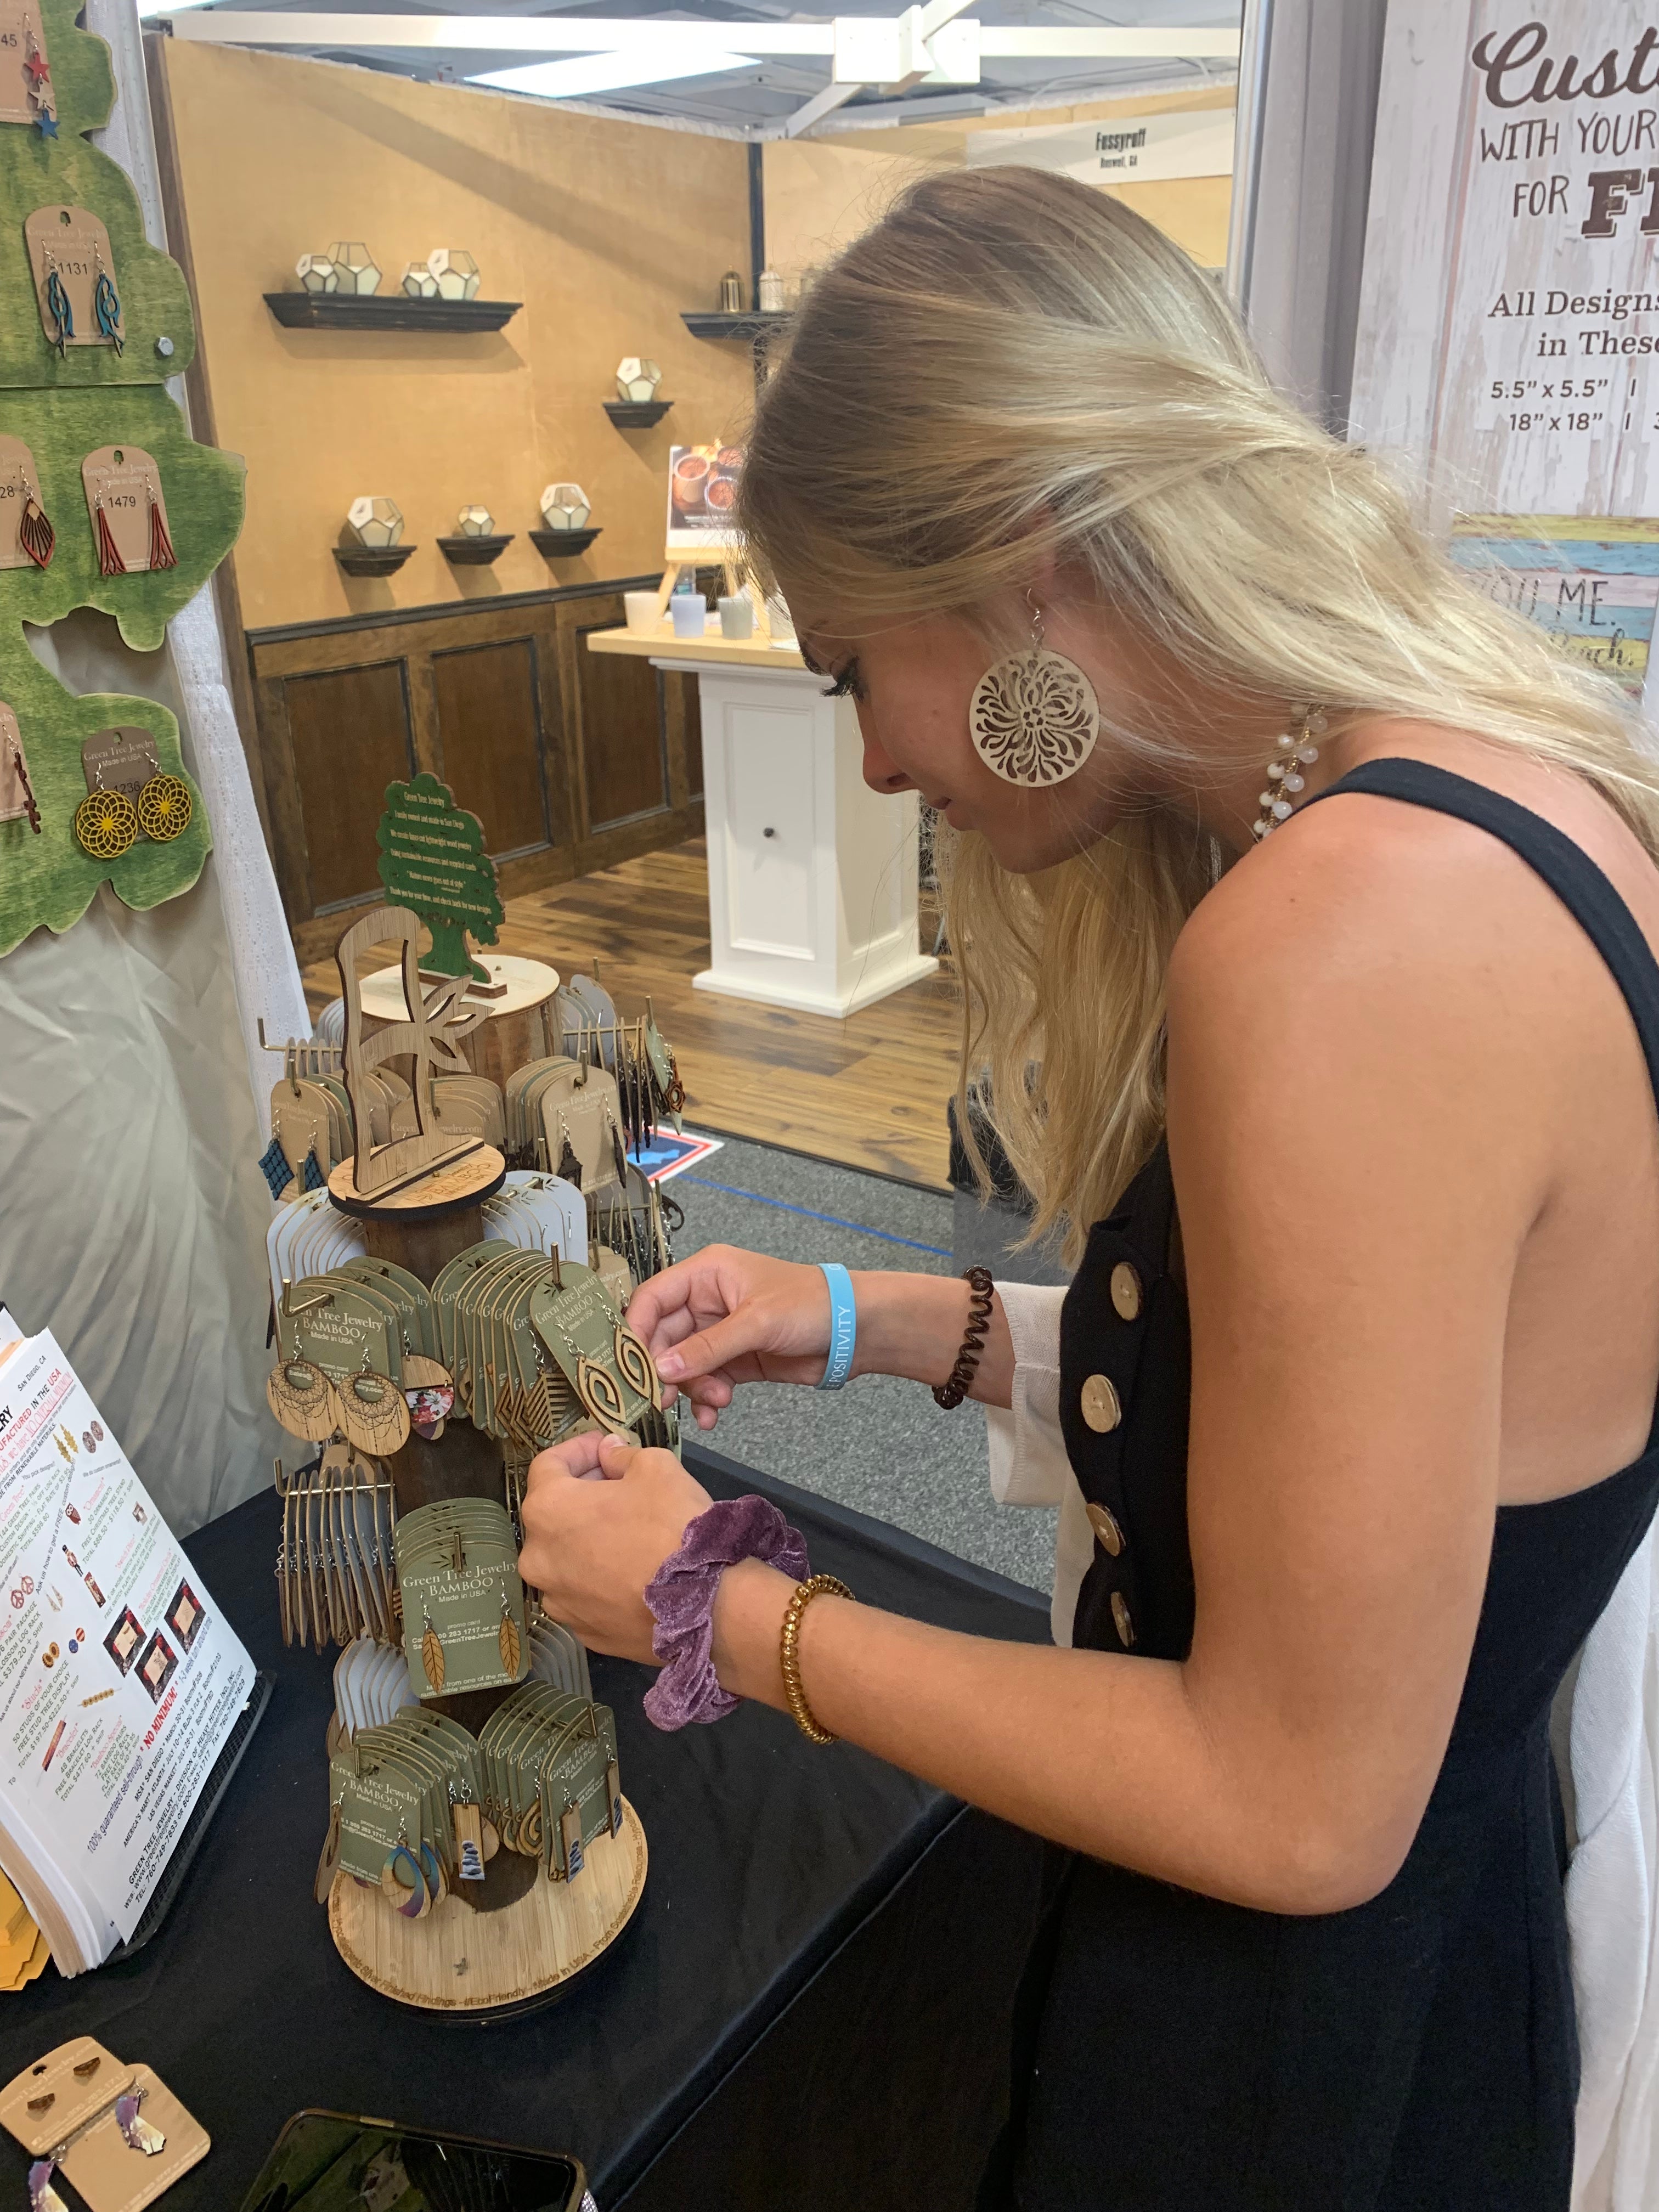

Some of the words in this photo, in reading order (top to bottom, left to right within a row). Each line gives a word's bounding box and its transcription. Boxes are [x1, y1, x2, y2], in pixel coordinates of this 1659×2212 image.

[1481, 119, 1559, 162] WITH
[1577, 109, 1656, 156] YOUR
[1513, 175, 1570, 218] FOR
[58, 262, 88, 275] 1131
[1488, 291, 1534, 318] All
[1537, 332, 1567, 357] in
[1541, 383, 1554, 398] x
[1548, 417, 1561, 431] x
[108, 496, 136, 508] 1479
[83, 751, 108, 761] Green
[109, 747, 127, 755] Tree
[129, 740, 155, 753] Jewelry
[101, 759, 120, 767] Made
[127, 753, 143, 761] USA
[114, 781, 140, 794] 1236
[535, 1306, 560, 1325] Green
[556, 1294, 575, 1308] Tree
[573, 1274, 599, 1300] Jewelry
[556, 1295, 593, 1324] BAMBOO
[303, 1319, 360, 1338] BAMBOO
[314, 1308, 341, 1322] Tree
[342, 1312, 383, 1332] Jewelry
[311, 1331, 329, 1340] Made
[338, 1336, 354, 1345] USA
[828, 1305, 851, 1383] POSITIVITY
[18, 1380, 27, 1391] SAN
[26, 1365, 40, 1381] DIEGO,
[39, 1355, 46, 1364] CA
[31, 1398, 38, 1409] IN
[37, 1384, 49, 1400] THE
[47, 1368, 61, 1385] USA
[3, 1474, 16, 1490] FROM
[14, 1444, 38, 1475] RENEWABLE
[36, 1423, 57, 1447] MATERIALS.
[41, 1571, 46, 1579] us
[54, 1508, 64, 1528] FREE
[61, 1483, 71, 1505] custom
[403, 1574, 440, 1588] Green
[443, 1568, 472, 1581] Tree
[474, 1561, 518, 1579] Jewelry
[430, 1577, 494, 1596] BAMBOO
[439, 1595, 459, 1603] Made
[469, 1589, 487, 1598] USA
[33, 1622, 43, 1638] SHIP
[449, 1629, 461, 1638] 283
[464, 1627, 480, 1635] 1717
[13, 1733, 20, 1743] 50
[19, 1711, 35, 1734] STUDS
[34, 1700, 40, 1711] OF
[40, 1683, 53, 1701] YOUR
[53, 1660, 69, 1683] CHOICE
[18, 1734, 30, 1753] FREE
[29, 1716, 41, 1735] STUD
[40, 1698, 53, 1716] TREE
[52, 1671, 70, 1700] DISPLAY
[18, 1751, 31, 1768] TOTAL
[70, 1675, 78, 1689] SHIP
[145, 1767, 154, 1782] SAN
[151, 1747, 163, 1769] DIEGO
[165, 1723, 177, 1743] MARCH
[175, 1705, 185, 1724] 30-31
[86, 1830, 103, 1854] 100%
[98, 1792, 125, 1835] guaranteed
[120, 1754, 144, 1796] sell-through
[142, 1730, 155, 1749] NO
[151, 1686, 178, 1734] MINIMUM!
[129, 1855, 145, 1884] GREEN
[143, 1832, 156, 1854] TREE
[156, 1797, 173, 1833] JEWELRY
[176, 1758, 193, 1791] DIVISION
[192, 1746, 200, 1758] OF
[197, 1723, 212, 1748] HEAVY
[208, 1699, 224, 1726] HITTER
[220, 1686, 231, 1702] IND.
[227, 1671, 238, 1686] INC.
[550, 1758, 572, 1781] Green
[349, 1779, 399, 1807] BAMBOO
[357, 1792, 372, 1804] Made
[379, 1801, 393, 1812] USA
[384, 1783, 419, 1806] Jewelry
[136, 1884, 146, 1903] TEL:
[177, 1808, 184, 1819] OR
[210, 1731, 219, 1746] FAX:
